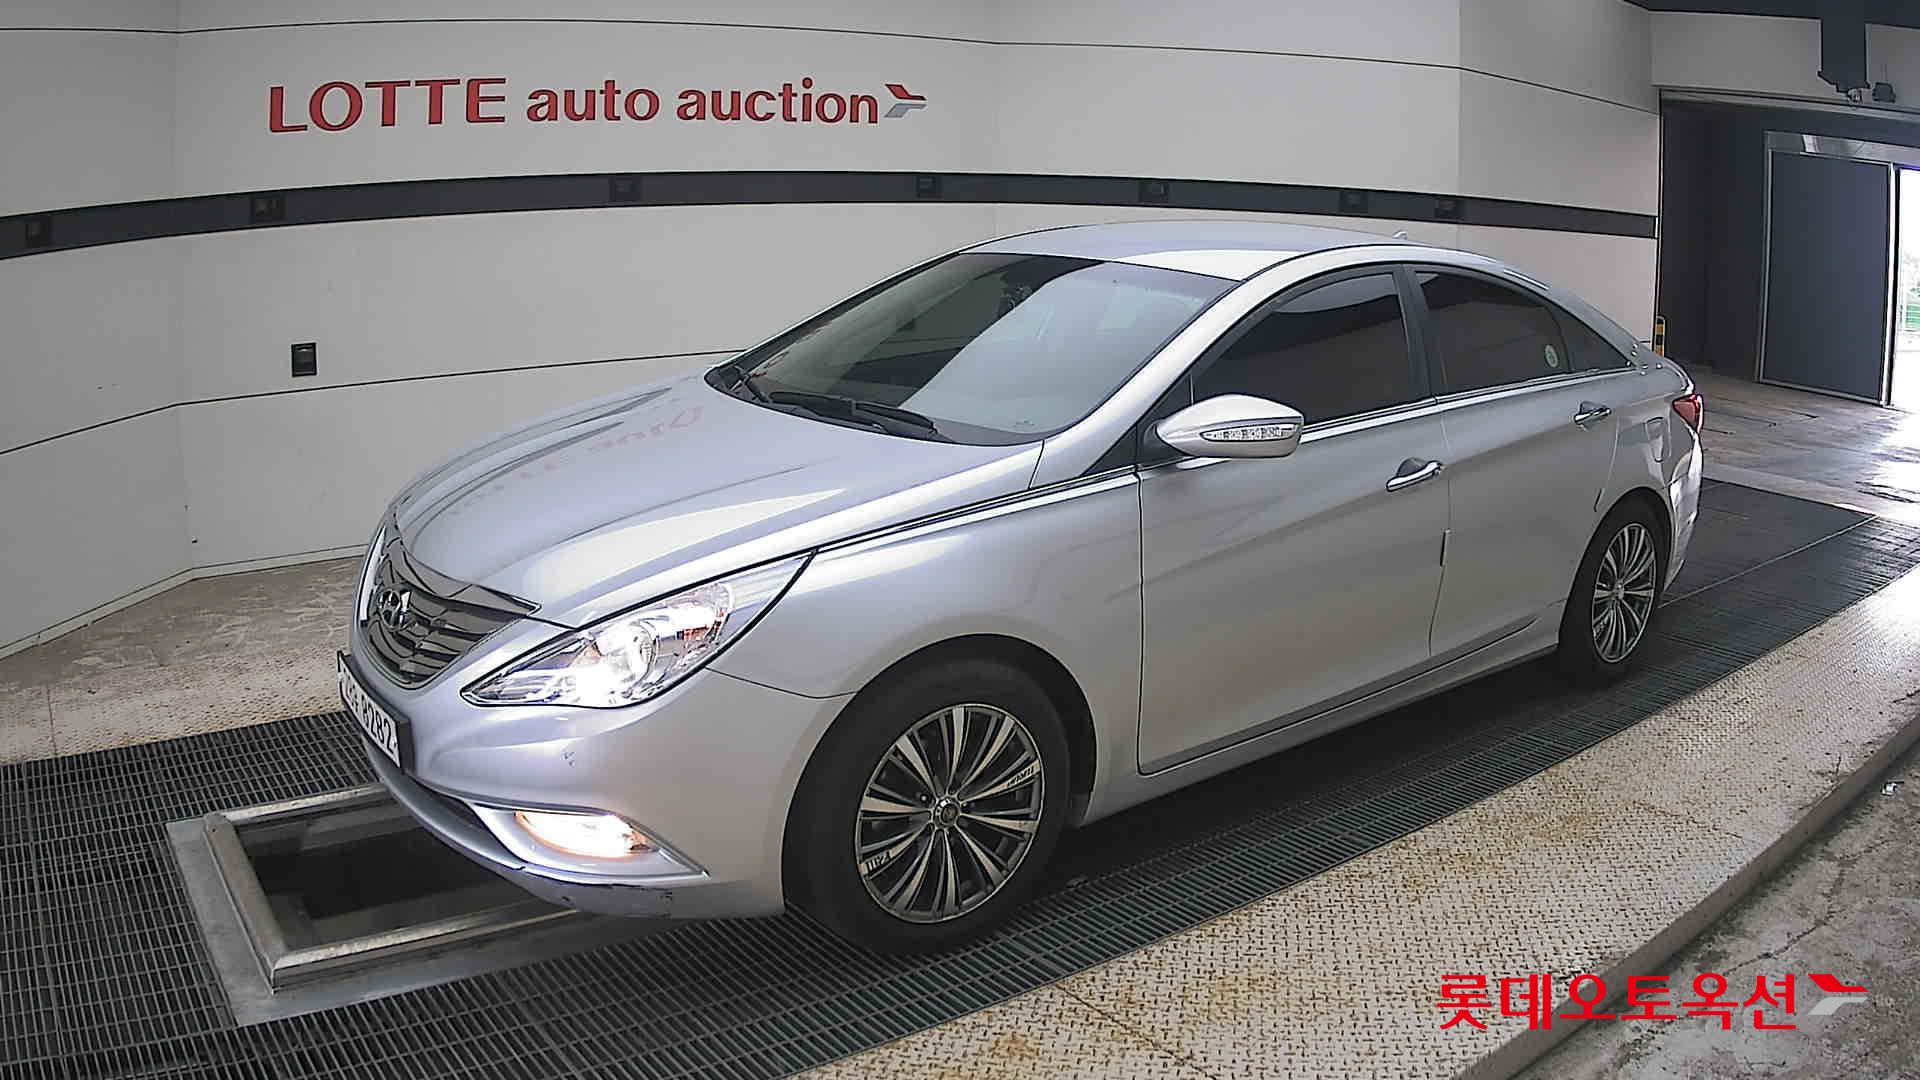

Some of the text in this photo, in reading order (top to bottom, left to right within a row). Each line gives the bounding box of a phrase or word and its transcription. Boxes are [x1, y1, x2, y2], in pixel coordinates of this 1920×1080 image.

[269, 77, 879, 133] LOTTE auto auction
